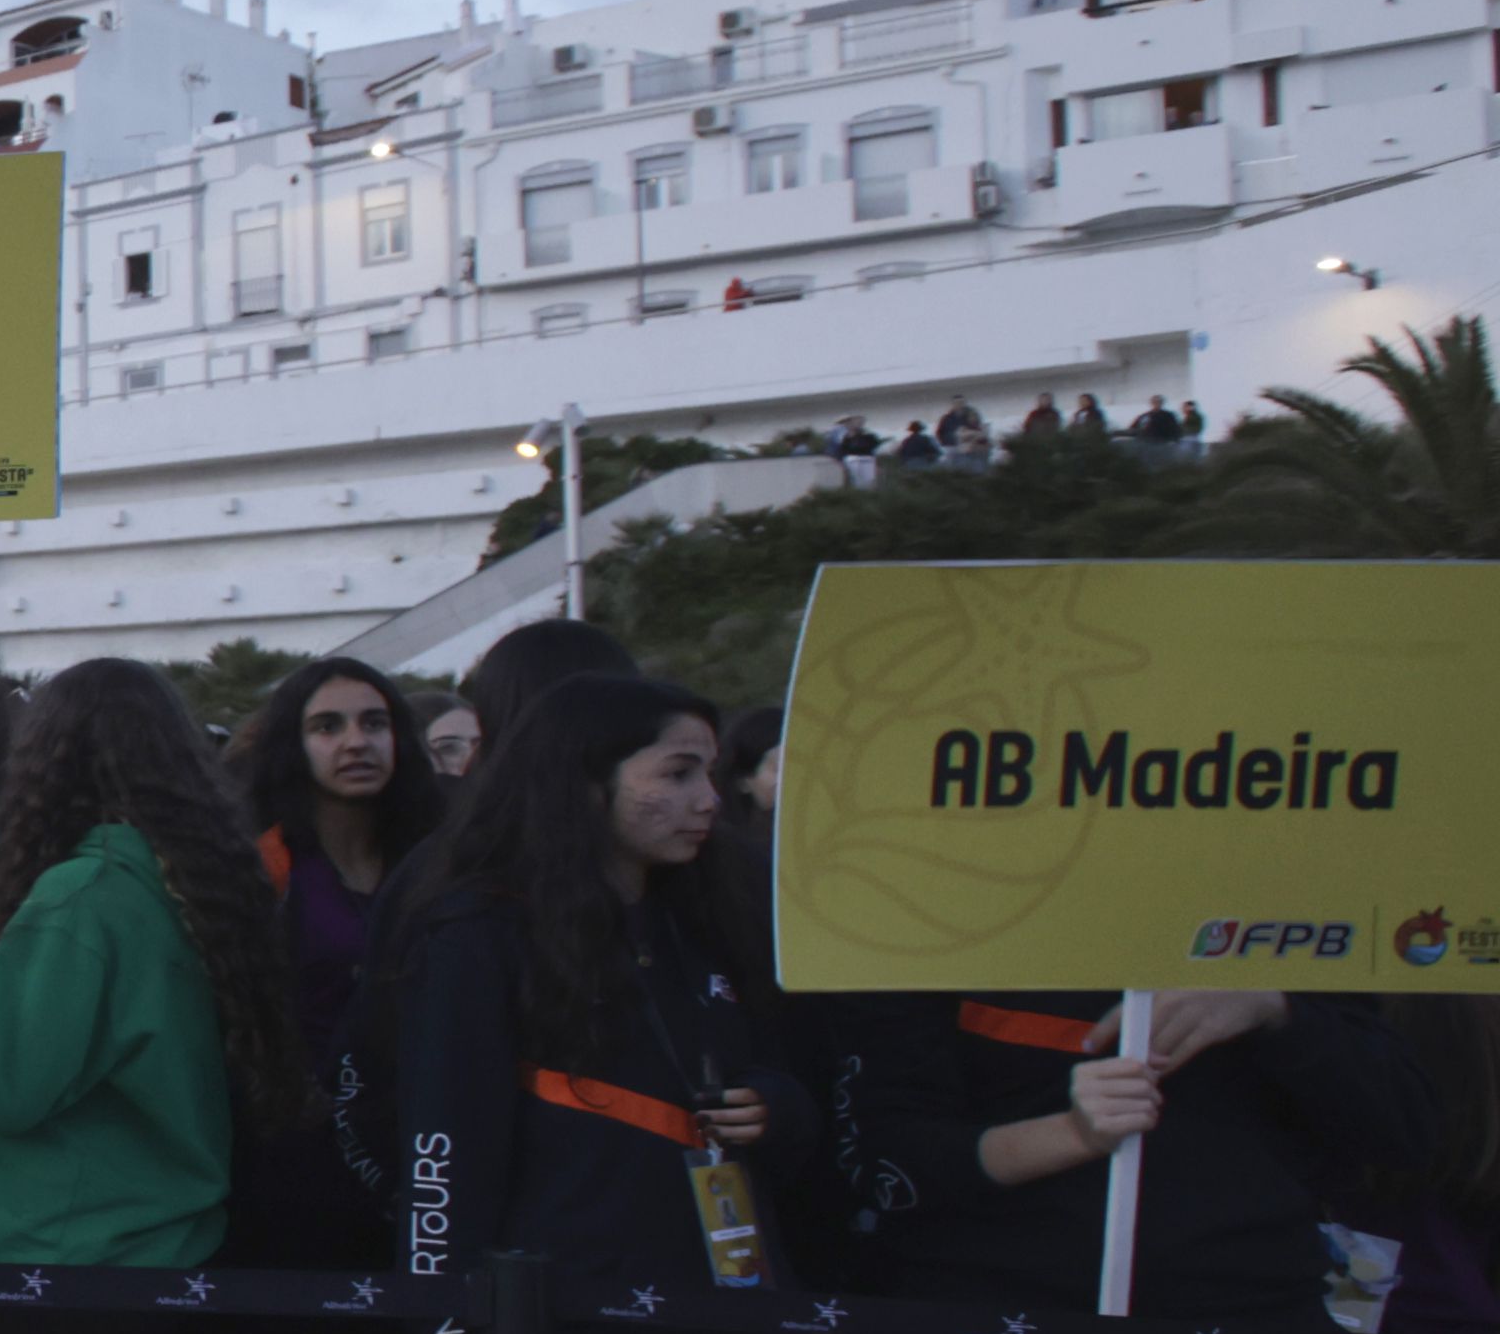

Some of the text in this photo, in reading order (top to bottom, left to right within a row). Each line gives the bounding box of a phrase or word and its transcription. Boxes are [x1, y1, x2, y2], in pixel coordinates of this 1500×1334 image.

[930, 729, 1399, 811] AB Madeira
[1238, 923, 1353, 957] FPB
